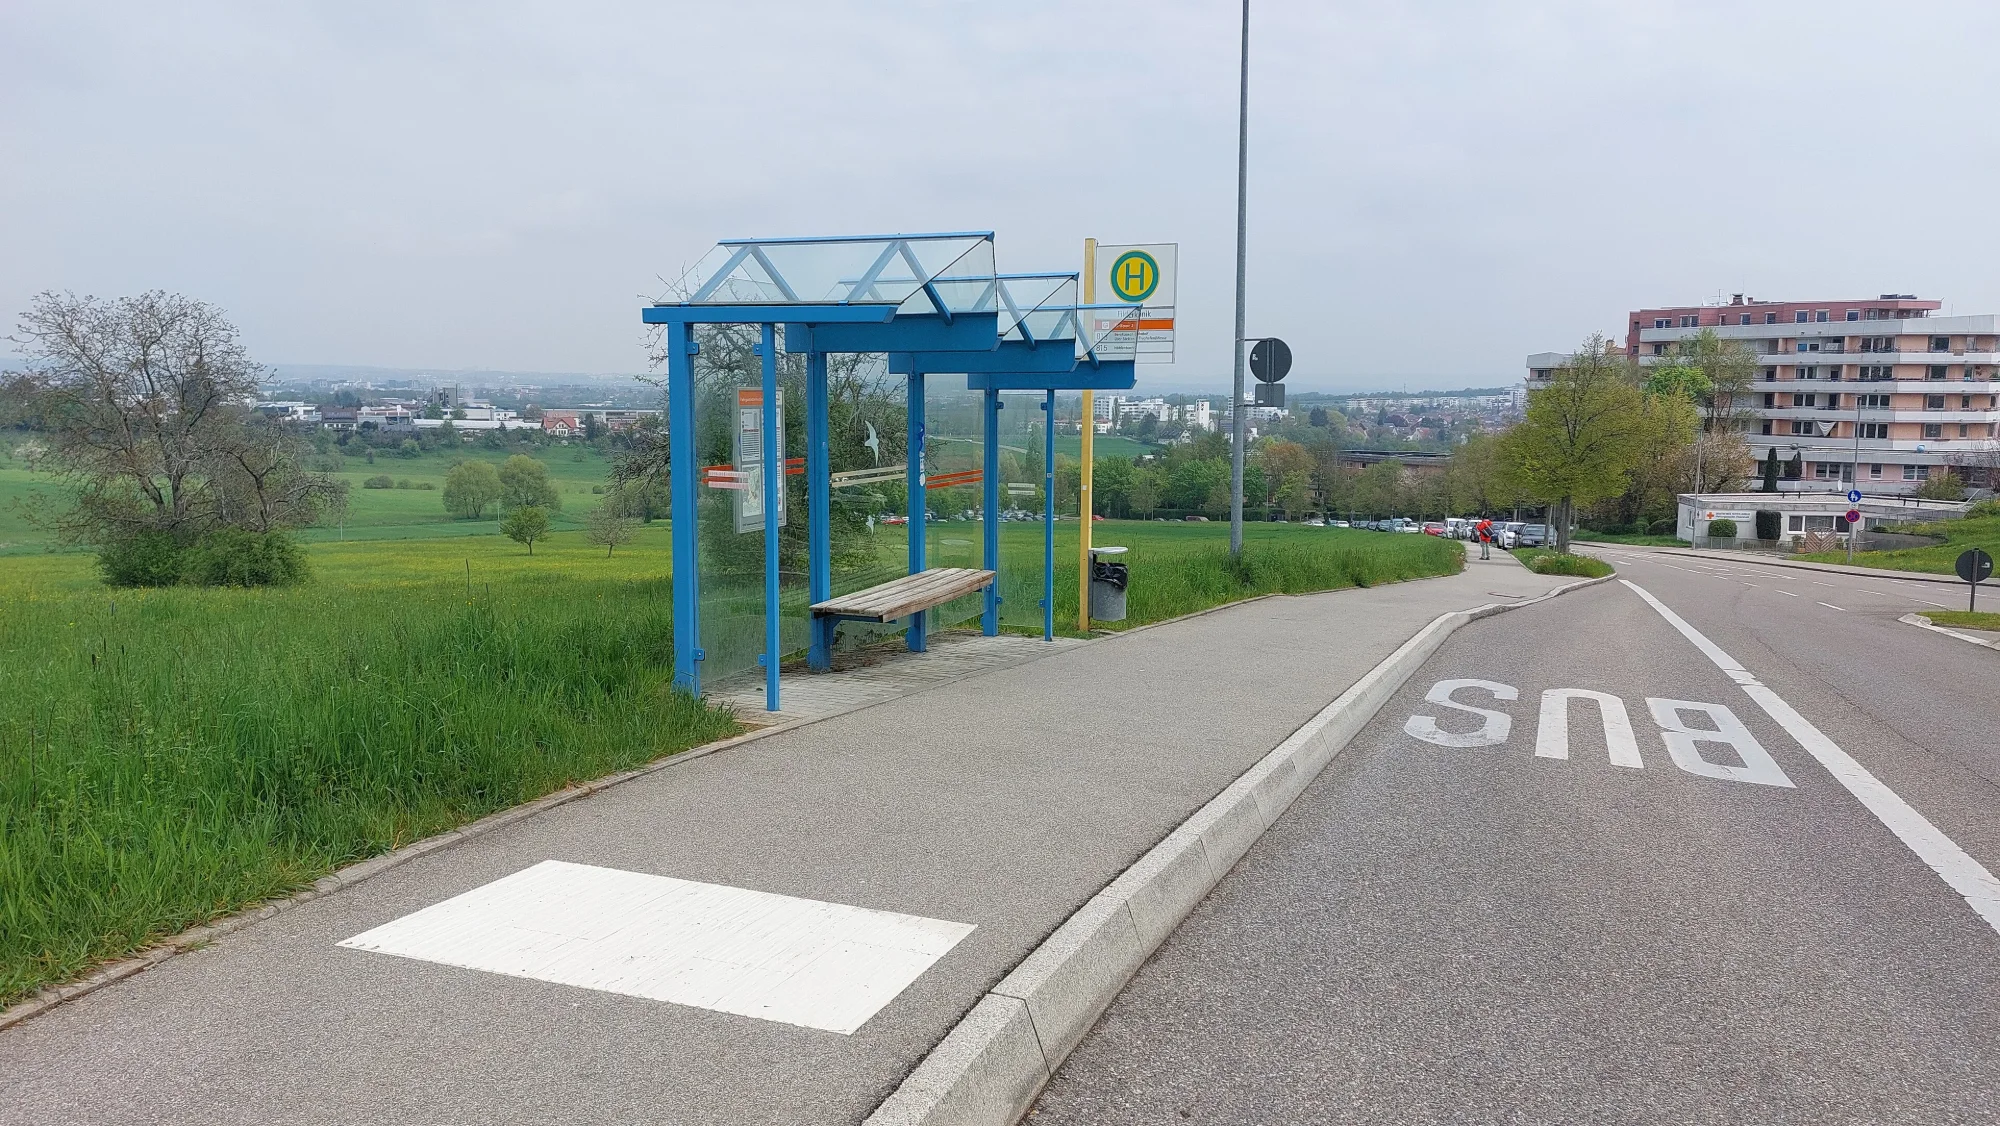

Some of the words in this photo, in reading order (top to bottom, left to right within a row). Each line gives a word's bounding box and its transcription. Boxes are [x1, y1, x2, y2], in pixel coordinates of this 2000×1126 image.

[1125, 263, 1145, 291] H
[1117, 310, 1152, 318] Fildrknik
[1404, 678, 1797, 788] BUS
